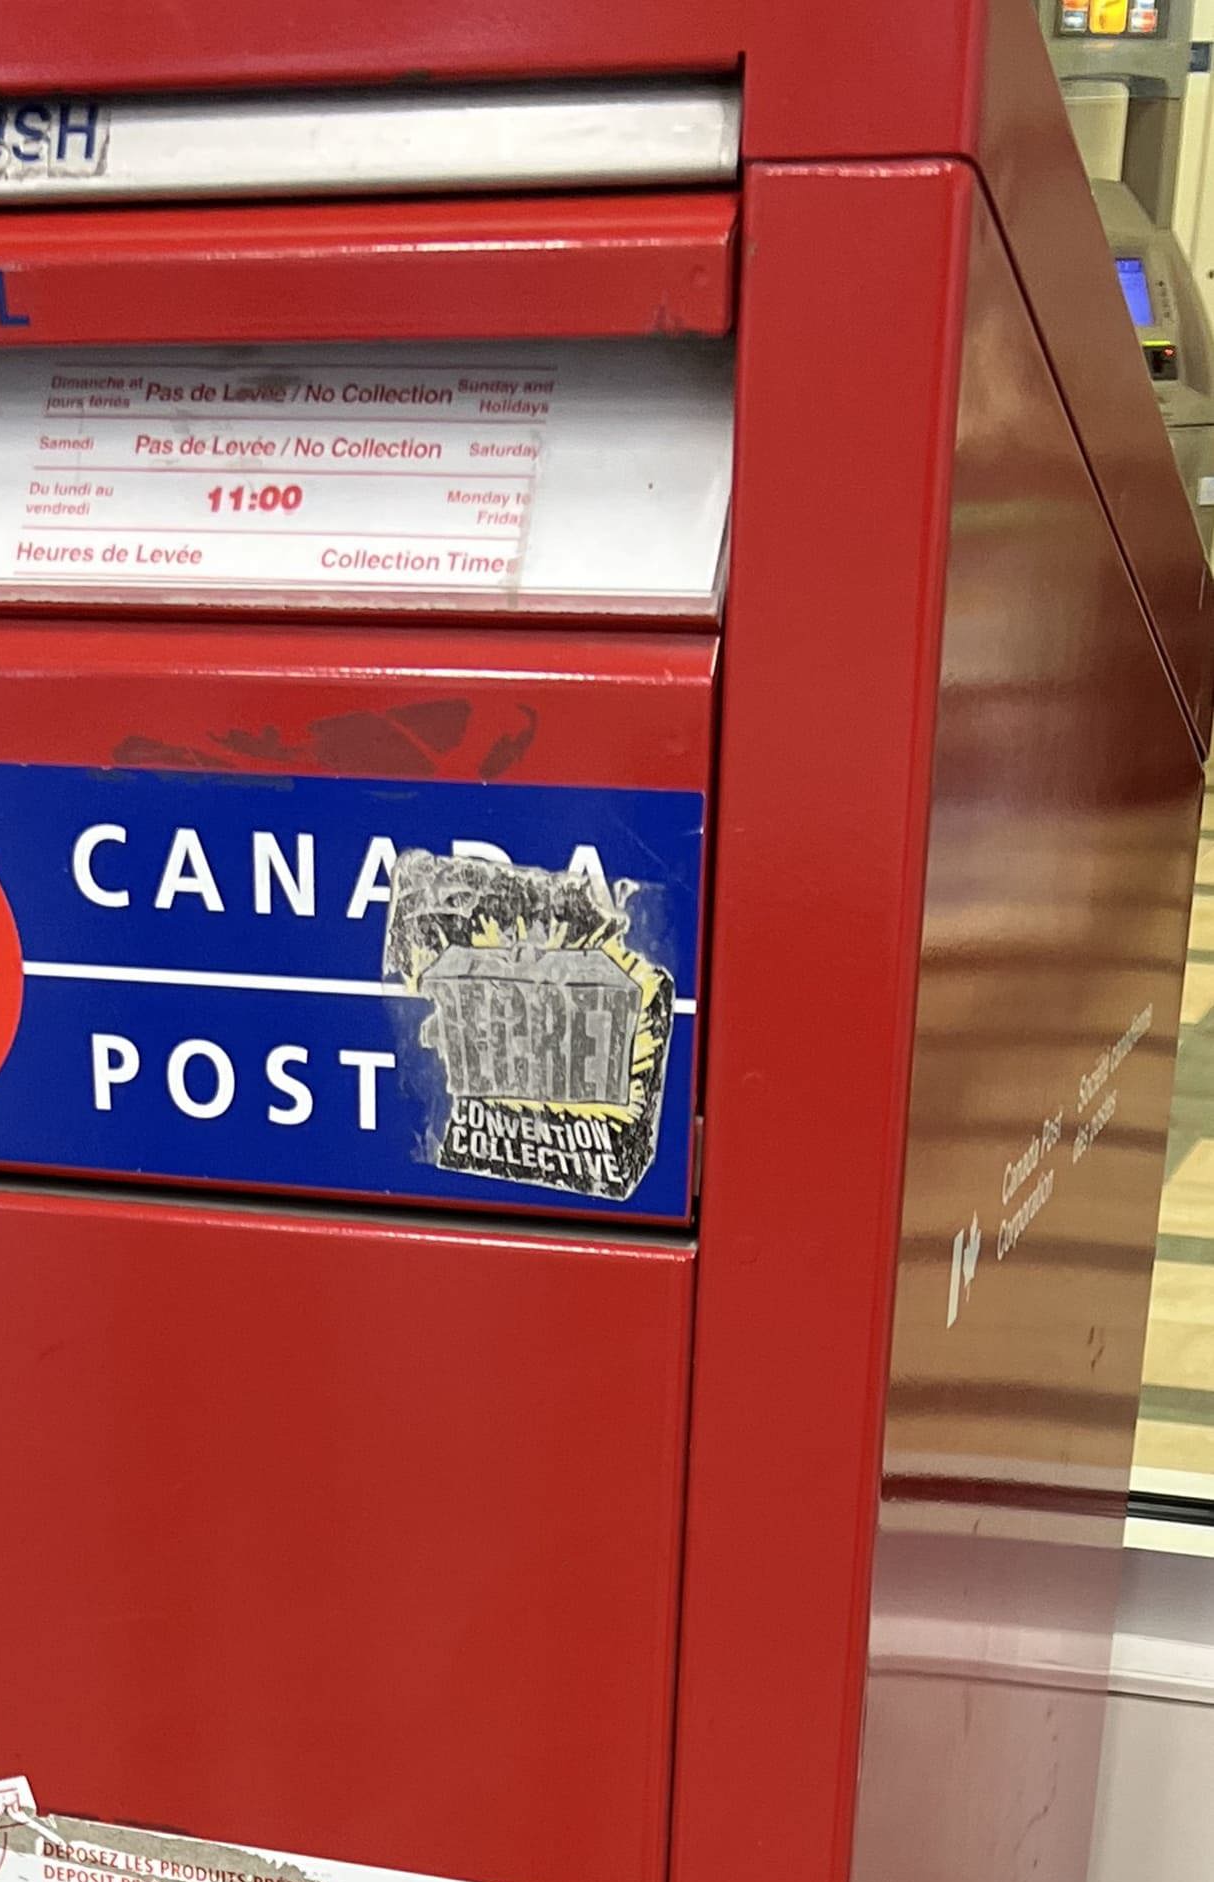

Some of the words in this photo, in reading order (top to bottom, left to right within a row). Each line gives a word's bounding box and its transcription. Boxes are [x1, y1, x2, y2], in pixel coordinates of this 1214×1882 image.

[50, 375, 125, 390] Dimanche
[457, 378, 519, 396] Sunday
[525, 380, 555, 395] and
[45, 394, 84, 411] jours
[145, 381, 185, 403] Pas
[190, 382, 217, 403] de
[223, 382, 287, 404] Levée
[304, 383, 335, 404] No
[341, 383, 454, 406] Collection
[478, 400, 550, 417] Holidays
[38, 436, 95, 451] Samedi
[134, 434, 174, 456] Pas
[179, 435, 207, 456] de
[211, 434, 277, 458] Levée
[293, 436, 325, 458] No
[330, 436, 443, 460] Collection
[469, 441, 542, 461] Saturday
[28, 481, 50, 497] Du
[53, 481, 92, 497] lundi
[94, 485, 115, 498] au
[206, 484, 304, 513] 11:00
[446, 489, 511, 509] Monday
[24, 499, 91, 516] vendredi
[15, 541, 95, 564] Heures
[101, 543, 129, 564] de
[135, 543, 204, 566] Levée
[320, 548, 440, 572] Collection
[72, 822, 620, 920] CANAA
[90, 1032, 397, 1131] POST
[451, 1098, 612, 1151] CONVENTION
[451, 1126, 624, 1183] COLLECTIVE
[125, 1854, 155, 1874] LES
